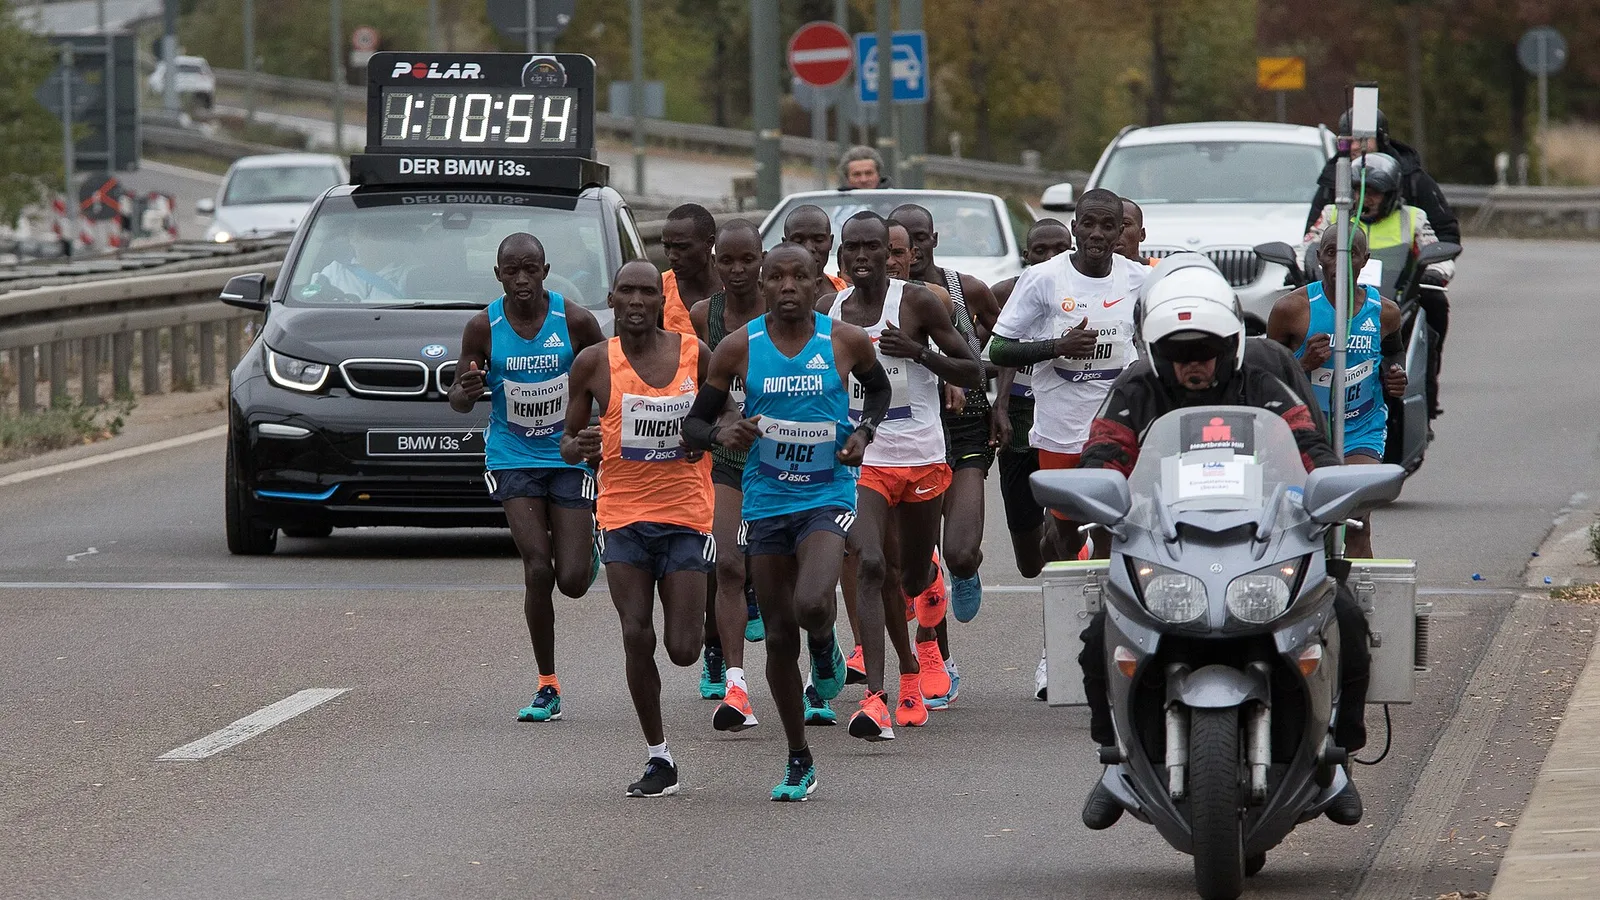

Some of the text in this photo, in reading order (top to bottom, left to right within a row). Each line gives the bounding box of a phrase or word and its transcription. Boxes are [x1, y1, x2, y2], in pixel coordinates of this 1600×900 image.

[391, 62, 482, 79] POLAR
[400, 93, 572, 143] 1:10:54
[400, 158, 531, 176] DER BMW i3s.
[506, 353, 559, 371] RUNCZECH
[521, 382, 564, 397] mainova
[763, 374, 823, 394] RUNCZECH
[513, 396, 562, 418] KENNETH
[645, 400, 690, 412] mainova
[534, 426, 554, 436] asics
[779, 427, 829, 438] mainova
[398, 436, 437, 450] BMW
[658, 440, 665, 448] 15
[655, 450, 677, 460] asics
[775, 442, 816, 463] PACE
[788, 473, 811, 482] asics
